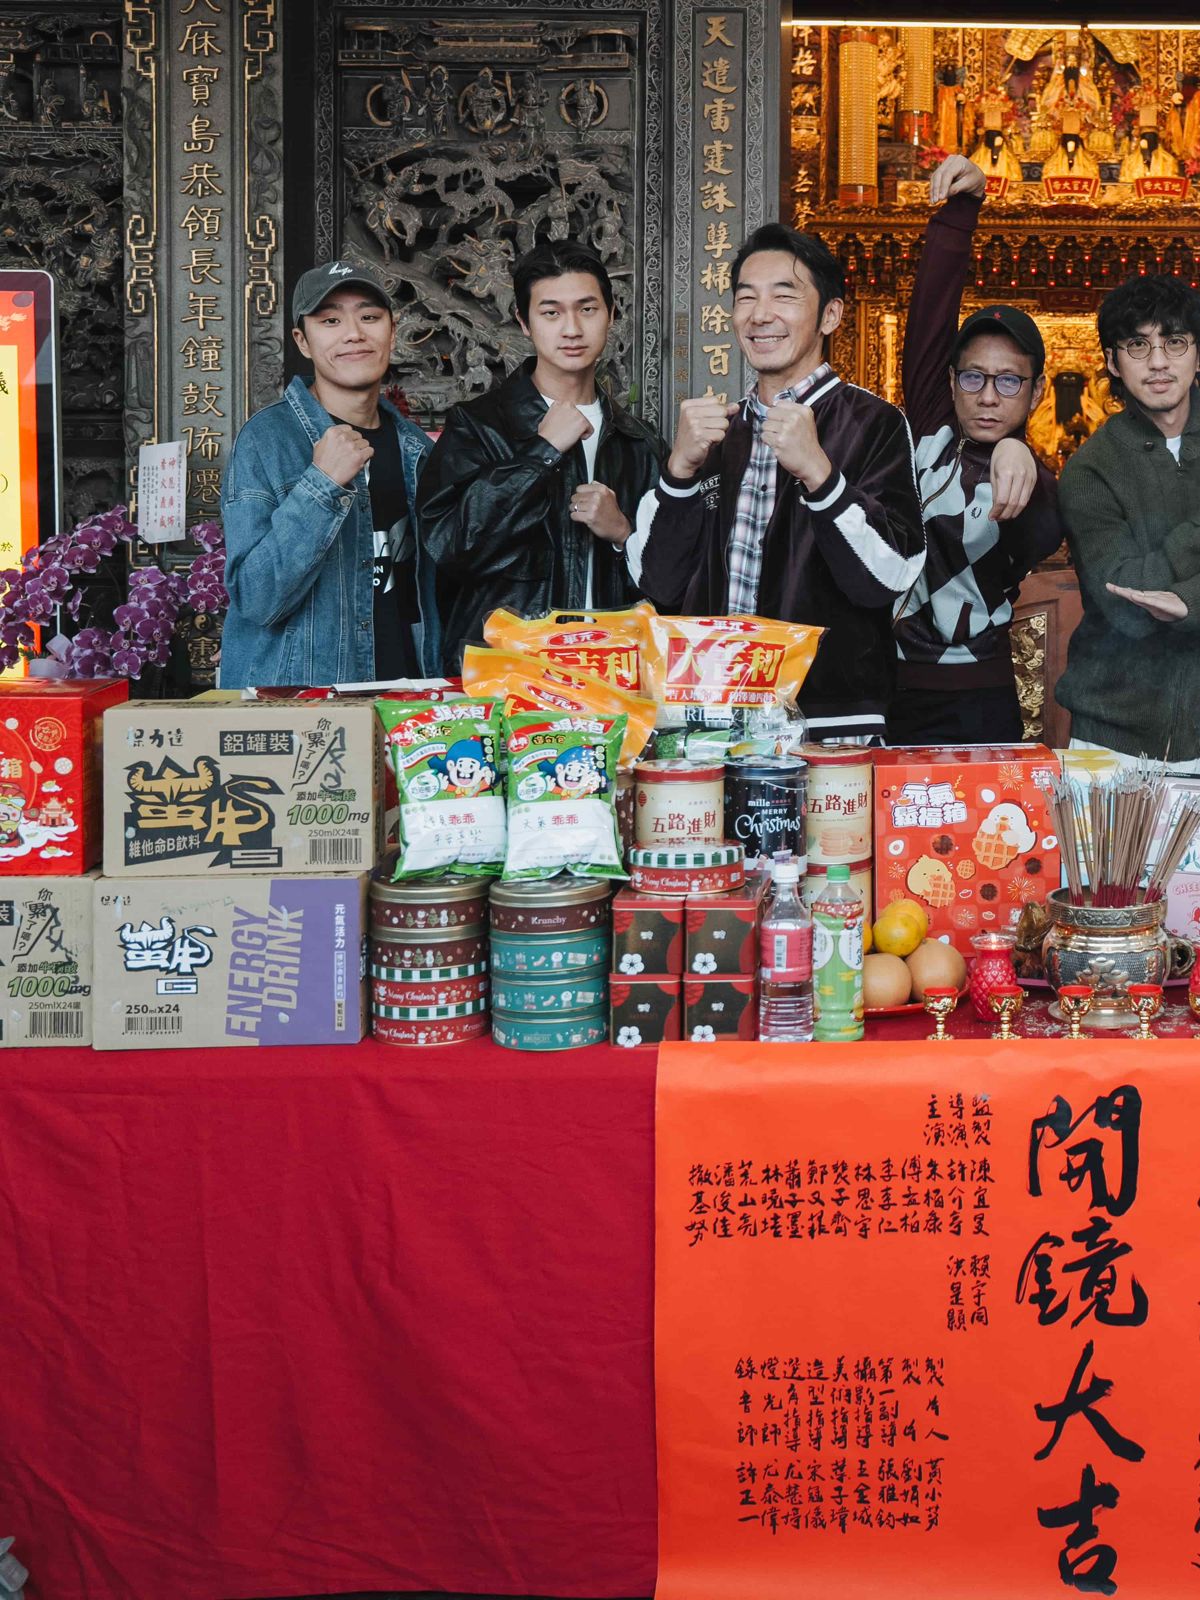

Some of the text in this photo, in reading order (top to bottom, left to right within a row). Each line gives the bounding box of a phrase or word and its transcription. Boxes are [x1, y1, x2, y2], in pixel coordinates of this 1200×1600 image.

[223, 732, 290, 754] 鋁罐裝
[761, 807, 788, 816] MERRY
[808, 791, 868, 816] 五路進財
[651, 810, 717, 836] 五路進財
[735, 813, 801, 840] Christmas
[128, 833, 201, 859] 維他命B飲料
[531, 915, 568, 925] Krunchy
[261, 904, 304, 1010] DRINK
[225, 905, 269, 1040] ENERGY
[923, 1093, 945, 1147] 主演
[947, 1092, 969, 1149] 導演
[1016, 1083, 1149, 1597] 開鏡大吉
